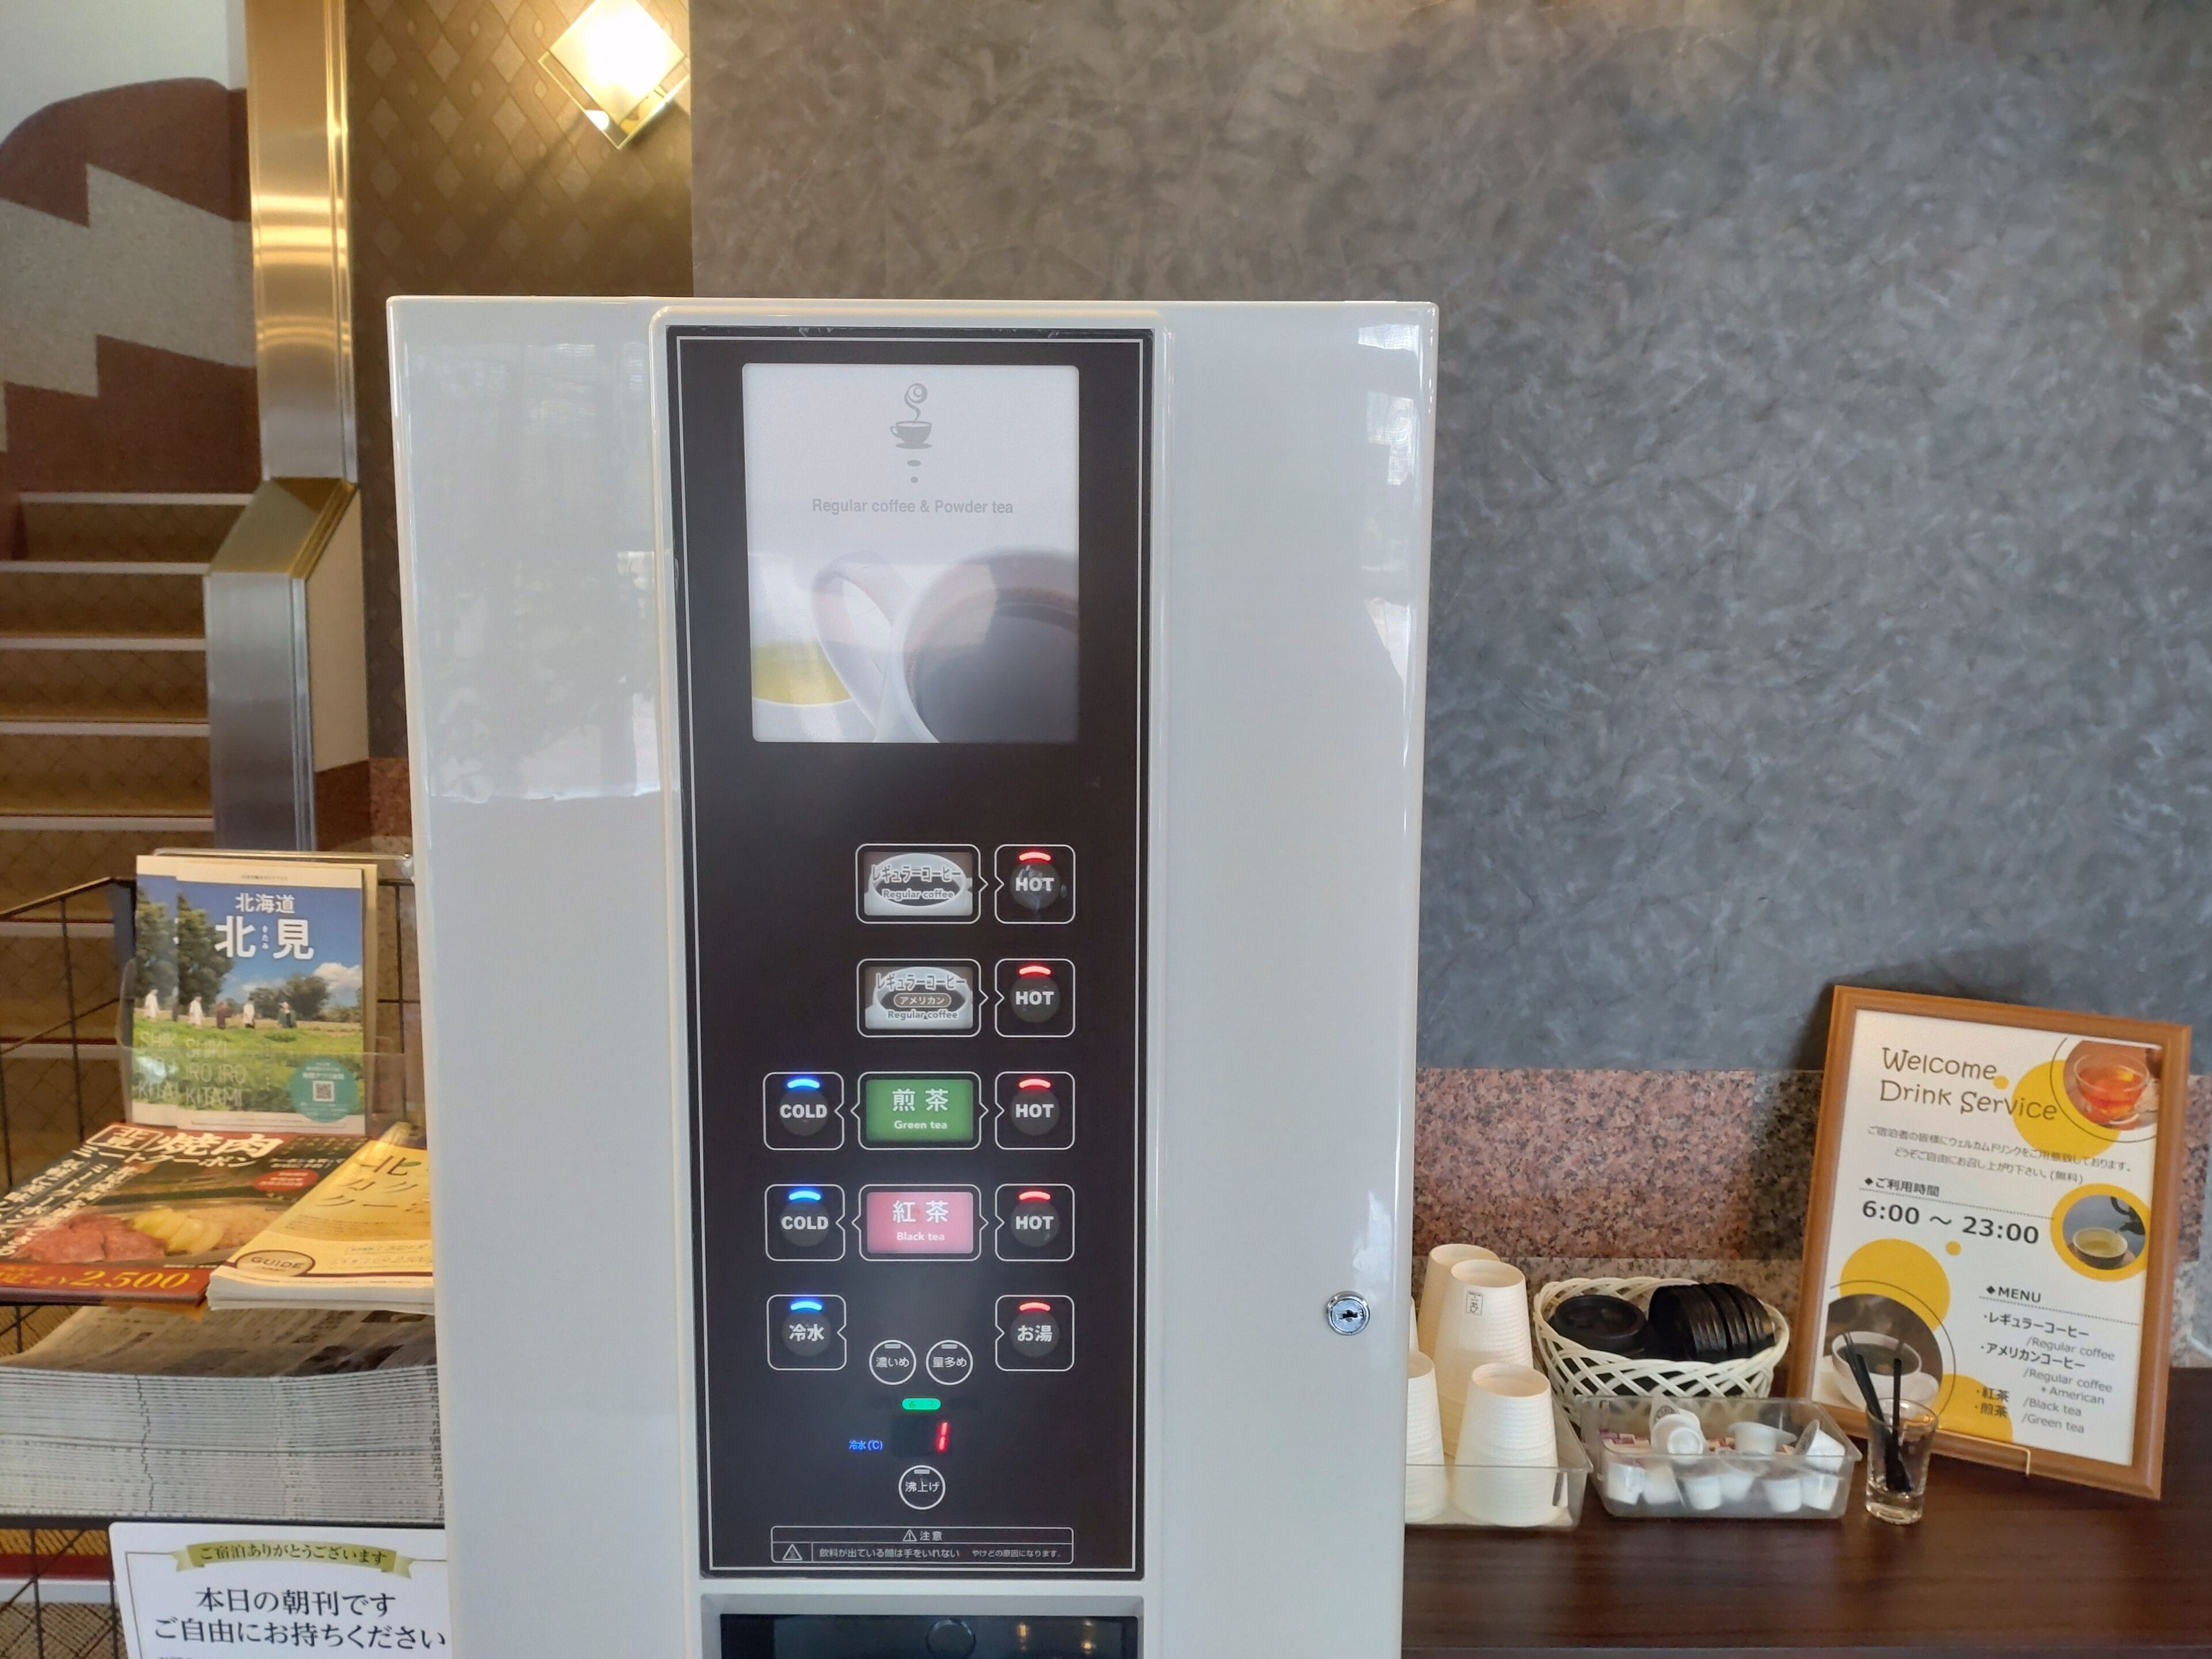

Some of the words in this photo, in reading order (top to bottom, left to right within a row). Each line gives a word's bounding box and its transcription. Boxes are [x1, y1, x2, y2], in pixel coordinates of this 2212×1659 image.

[812, 498, 868, 516] Regular
[872, 499, 916, 513] coffee
[920, 499, 930, 513] &
[935, 499, 988, 514] Powder
[993, 501, 1014, 514] tea
[872, 865, 961, 882] レギュラーコーヒー
[1016, 877, 1054, 892] HOT
[883, 890, 921, 900] Regular
[923, 889, 954, 899] coffee
[236, 893, 294, 914] 北海道
[215, 915, 315, 960] 北見
[877, 974, 965, 990] レギュラーコーヒー
[900, 997, 945, 1005] アメリカン
[1016, 991, 1054, 1005] HOT
[888, 1010, 924, 1020] Regular
[928, 1009, 957, 1018] coffee
[1881, 1047, 1997, 1081] Welcome
[1880, 1080, 1952, 1106] Drink
[1961, 1090, 2058, 1120] Service
[780, 1104, 827, 1119] COLD
[1016, 1104, 1054, 1118] HOT
[893, 1120, 927, 1130] Green
[930, 1120, 948, 1130] tea
[144, 1132, 284, 1157] 焼肉
[1876, 1177, 1940, 1198] ご利用時間
[781, 1215, 829, 1230] COLD
[1016, 1215, 1054, 1230] HOT
[1862, 1200, 1919, 1225] 6:00
[1962, 1215, 2039, 1245] 23:00
[896, 1232, 925, 1241] Black
[927, 1232, 945, 1241] tea
[251, 1257, 305, 1268] GUIDE
[1998, 1286, 2041, 1303] MENU
[789, 1324, 824, 1342] 冷水
[1017, 1325, 1053, 1342] お湯
[2080, 1346, 2115, 1361] coffee
[876, 1357, 910, 1368] 濃いめ
[933, 1357, 967, 1368] 量多め
[2077, 1377, 2112, 1393] coffee
[2049, 1387, 2104, 1404] American
[2063, 1404, 2082, 1416] tea
[2066, 1421, 2084, 1433] tea
[938, 1421, 948, 1450] 1
[905, 1480, 940, 1493] 沸上げ
[919, 1531, 942, 1541] 注意
[200, 1543, 387, 1566] ご宿泊ありがとうございます
[195, 1587, 396, 1617] 本日の朝刊です
[154, 1616, 446, 1649] ご自由にお持ちください
